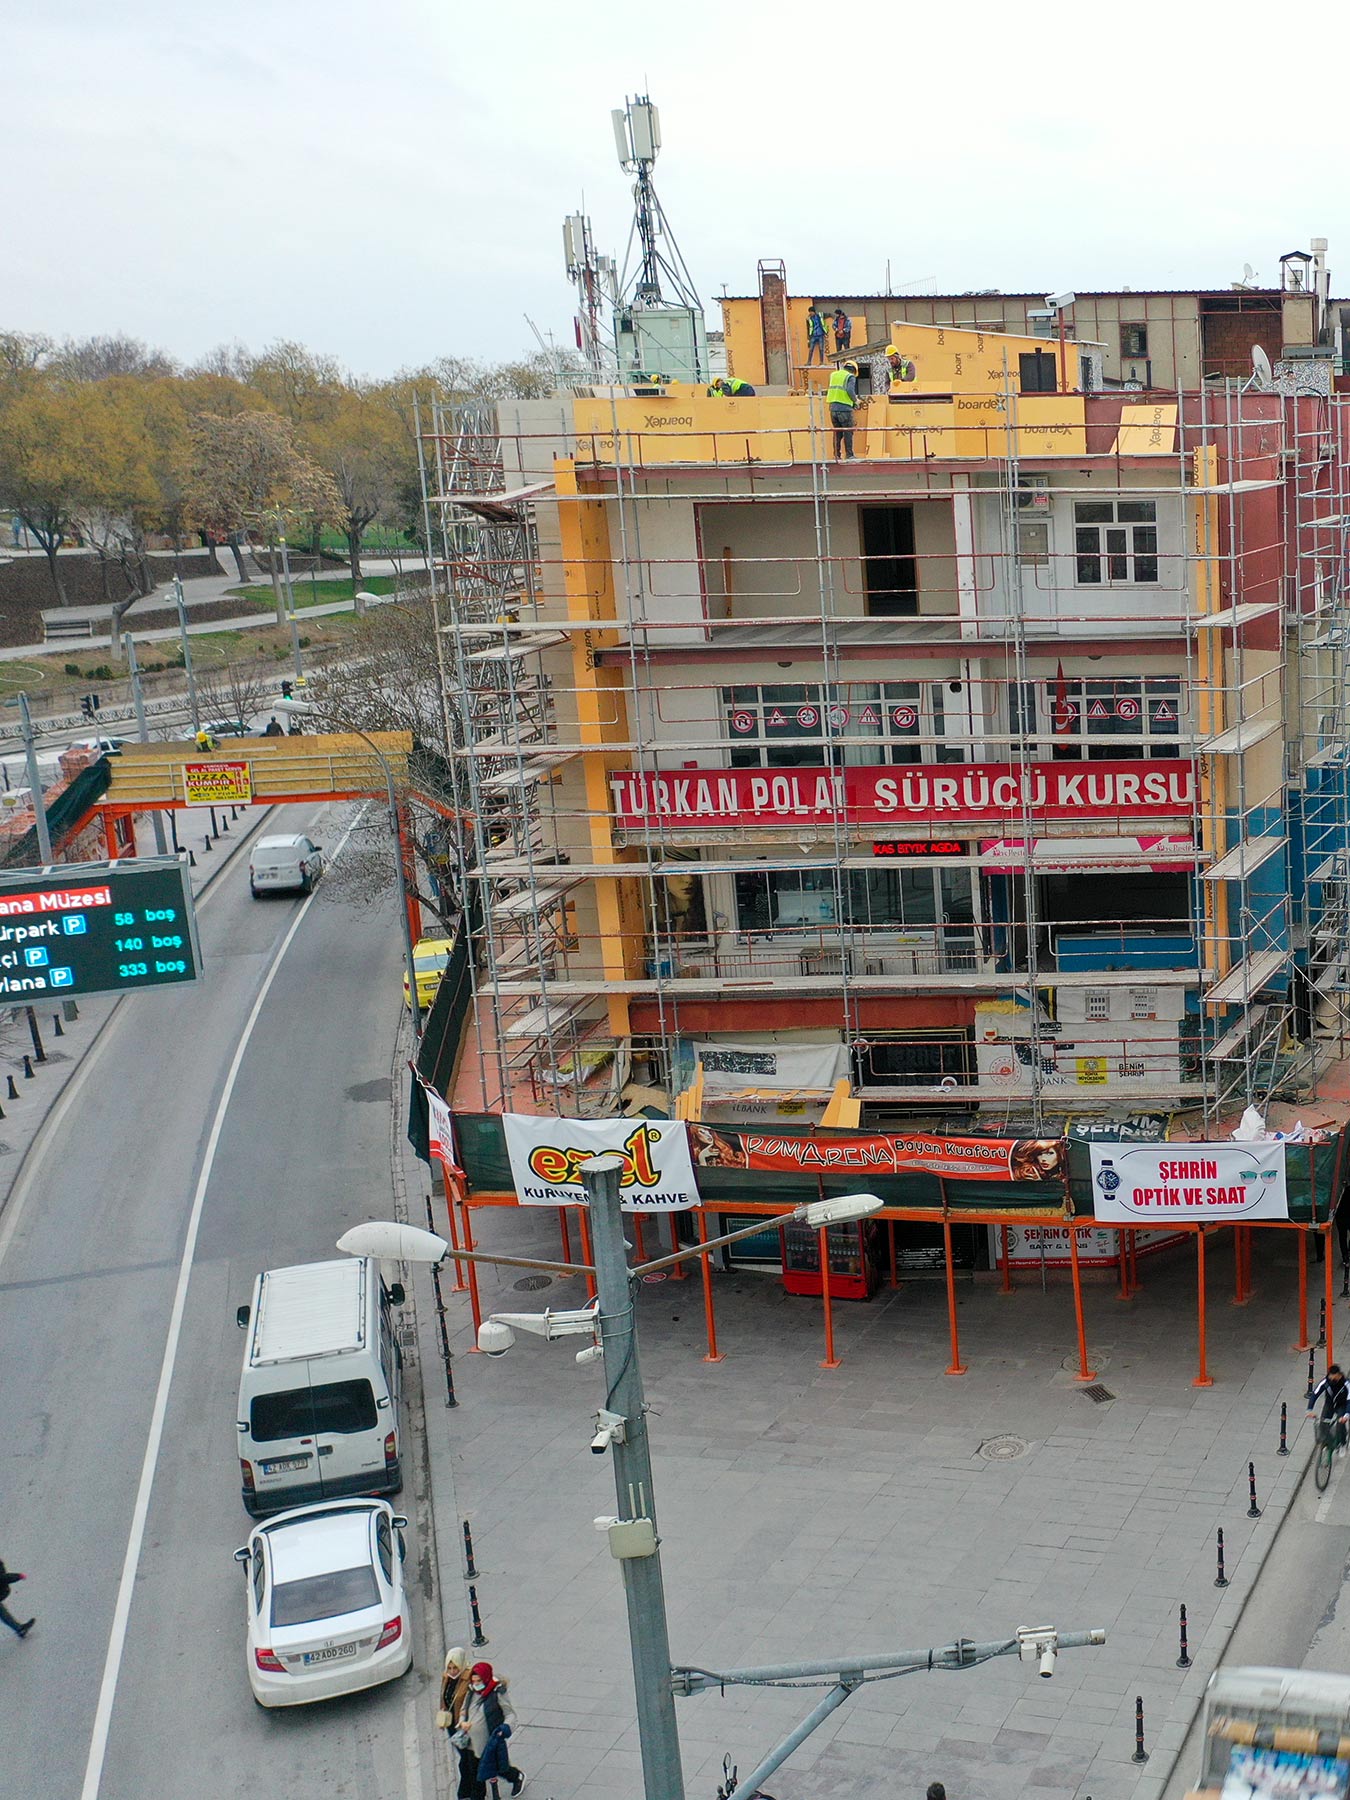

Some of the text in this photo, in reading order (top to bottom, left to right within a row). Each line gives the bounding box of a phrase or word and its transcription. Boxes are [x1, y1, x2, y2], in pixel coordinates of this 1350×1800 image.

[958, 398, 1007, 411] boardeX
[643, 415, 693, 428] boardeX
[1024, 423, 1072, 435] boardeX
[610, 772, 739, 818] TÜRKAN
[874, 771, 1047, 812] SÜRÜCÜ
[1057, 772, 1194, 807] KURSU
[40, 888, 112, 911] Müzesi
[115, 913, 135, 926] 58
[145, 908, 176, 923] boş
[115, 938, 143, 951] 140
[152, 935, 183, 949] boş
[119, 962, 147, 977] 333
[155, 960, 186, 974] boş
[894, 1139, 1009, 1159] Bayan Kuaförü
[1158, 1158, 1218, 1184] ŞEHRİN
[632, 1192, 689, 1205] KAHVE
[1132, 1185, 1247, 1207] OPTİK VE SAAT
[310, 1651, 320, 1662] 42
